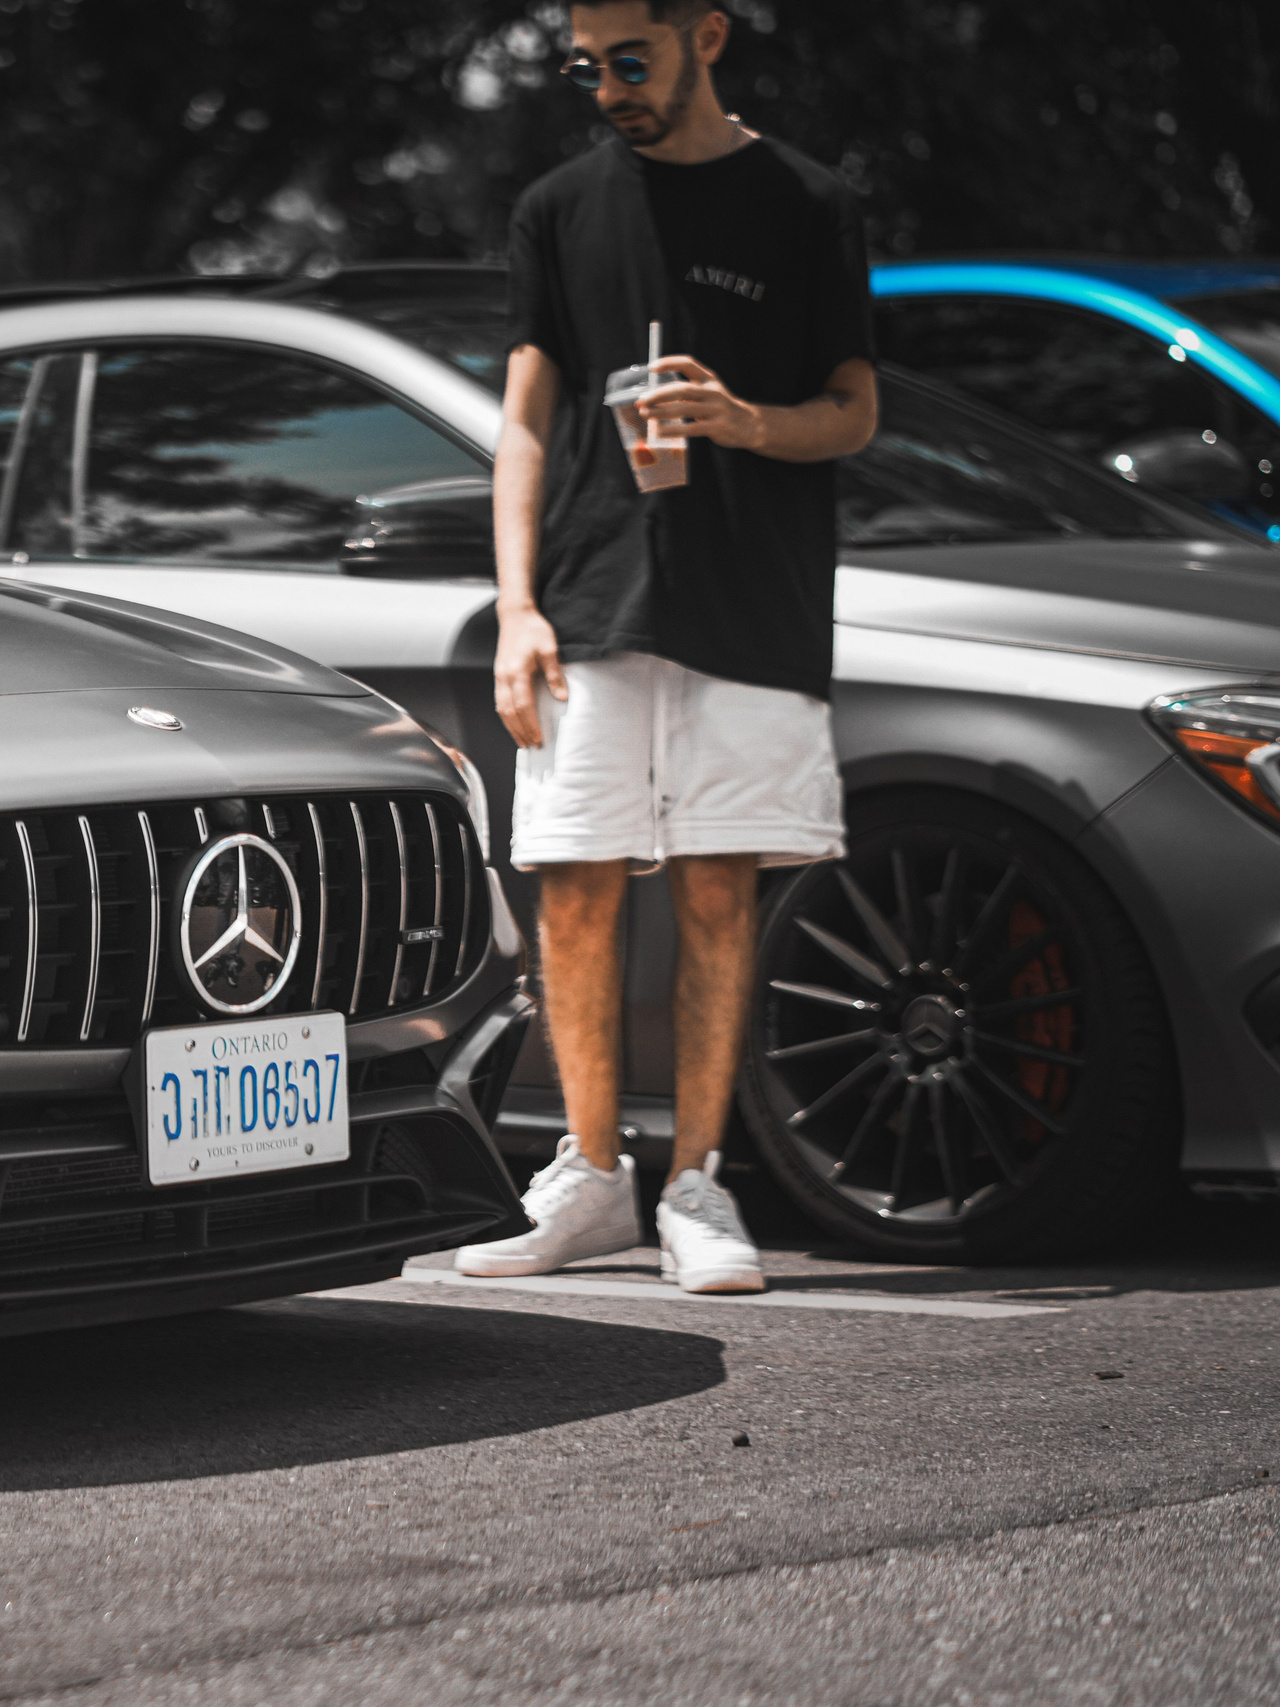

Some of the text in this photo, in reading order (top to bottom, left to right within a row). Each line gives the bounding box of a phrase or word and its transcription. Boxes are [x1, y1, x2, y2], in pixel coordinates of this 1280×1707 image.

[212, 1032, 288, 1060] ONTARIO
[207, 1137, 298, 1158] YOURS TO DISCOVER
